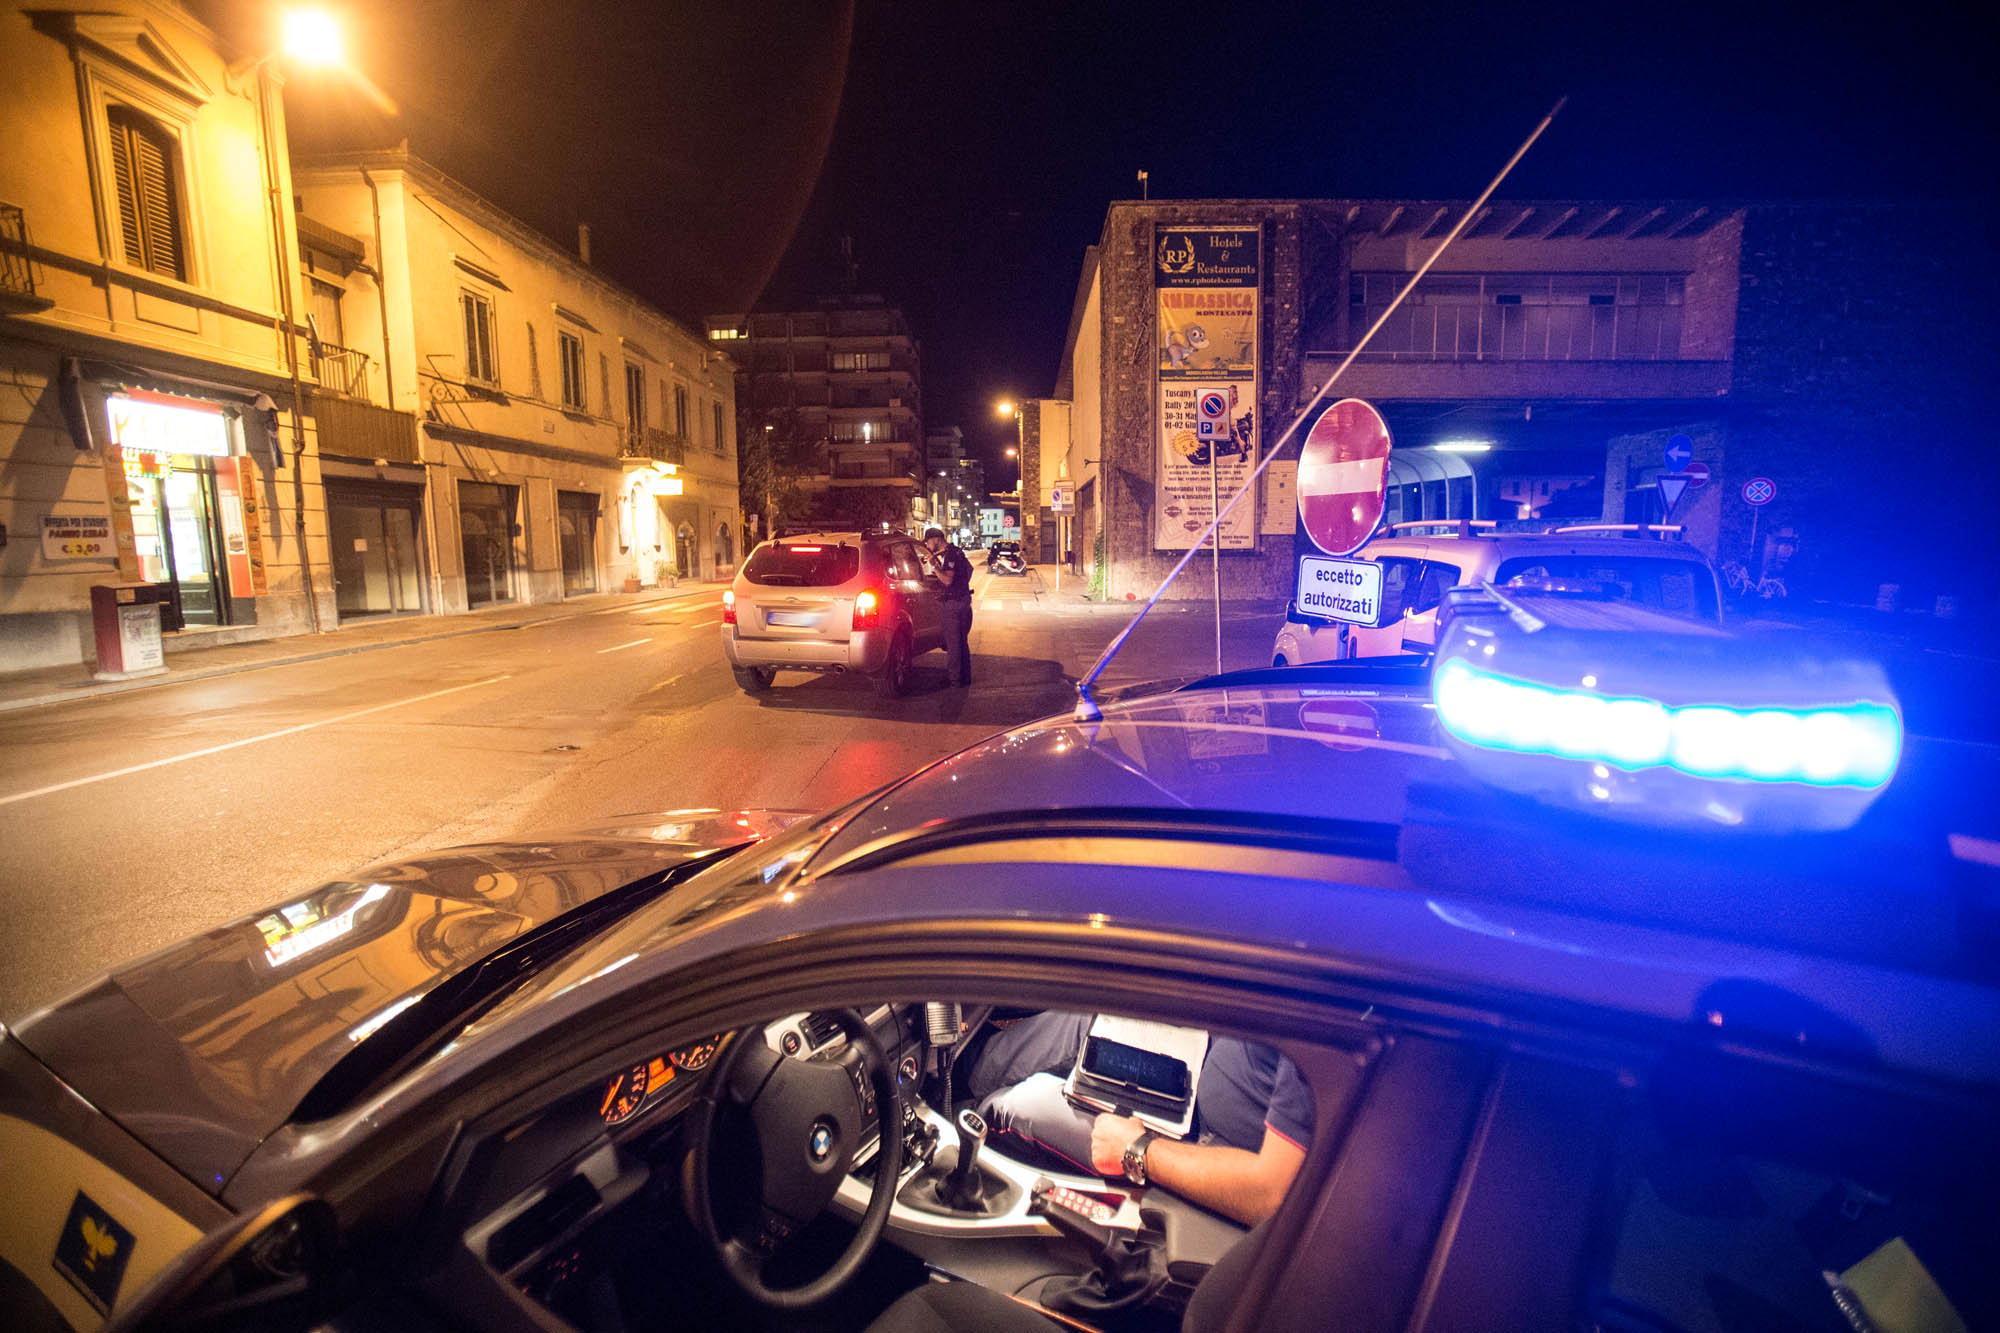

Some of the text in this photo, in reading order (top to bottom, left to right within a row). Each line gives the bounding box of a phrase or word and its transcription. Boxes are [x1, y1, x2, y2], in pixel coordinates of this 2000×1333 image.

[1210, 233, 1243, 247] Hotels
[1166, 250, 1187, 263] RP
[1197, 262, 1256, 274] Restaurants
[1171, 277, 1242, 285] www.rphotels.com
[1165, 389, 1191, 398] Tuscany
[1165, 401, 1181, 410] Rally
[1316, 568, 1363, 586] eccetto
[1304, 591, 1372, 615] autorizzati
